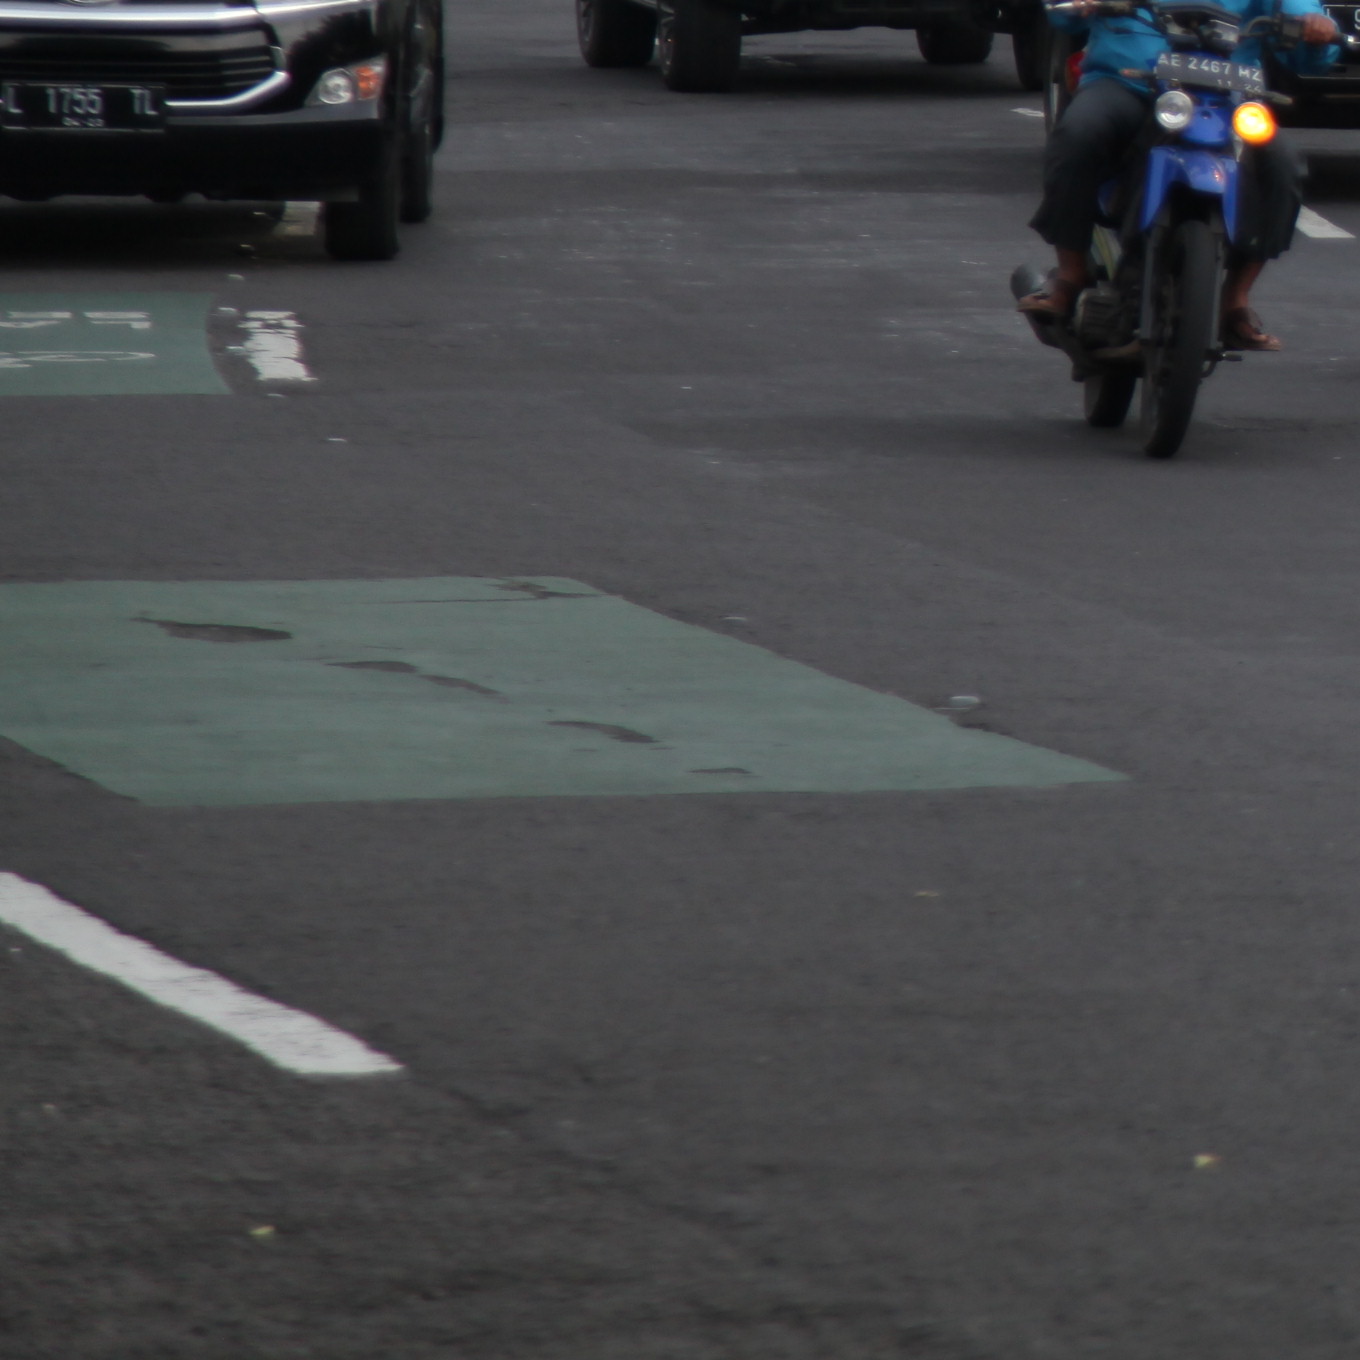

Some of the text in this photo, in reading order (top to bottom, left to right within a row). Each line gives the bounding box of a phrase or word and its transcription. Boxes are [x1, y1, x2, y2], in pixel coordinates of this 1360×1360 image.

[1158, 53, 1181, 67] AE
[1187, 57, 1232, 75] 2467
[7, 88, 159, 115] L 1755 TL
